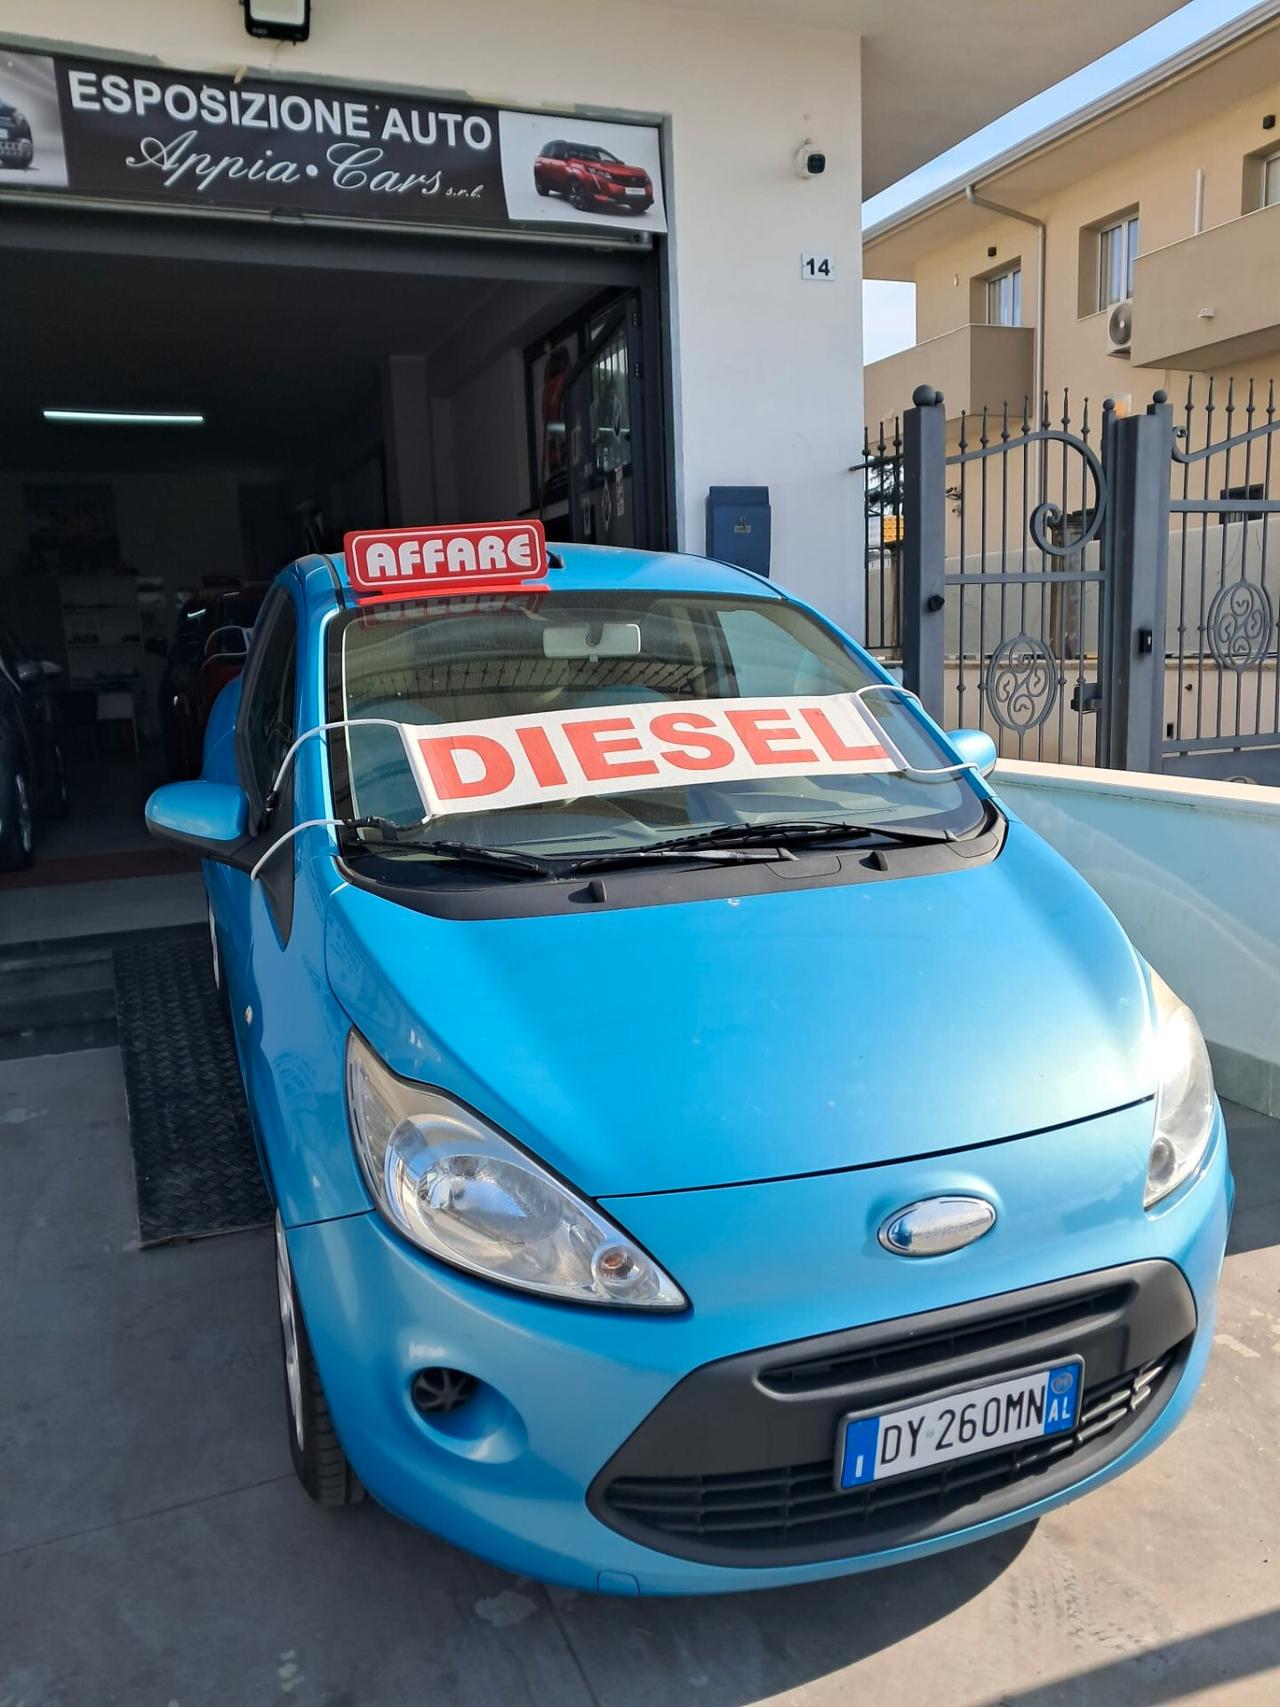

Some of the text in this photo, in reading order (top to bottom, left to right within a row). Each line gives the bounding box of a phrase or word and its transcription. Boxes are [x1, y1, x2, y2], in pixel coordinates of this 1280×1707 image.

[68, 69, 493, 150] ESPOSIZIONE AUTO
[125, 129, 484, 198] Appia Cars s.r.l.
[806, 257, 831, 276] 14
[366, 533, 532, 578] AFFARE
[418, 707, 891, 801] DIESEL
[880, 1415, 926, 1466] DY
[935, 1384, 1046, 1451] 260MN
[1048, 1396, 1071, 1422] AL
